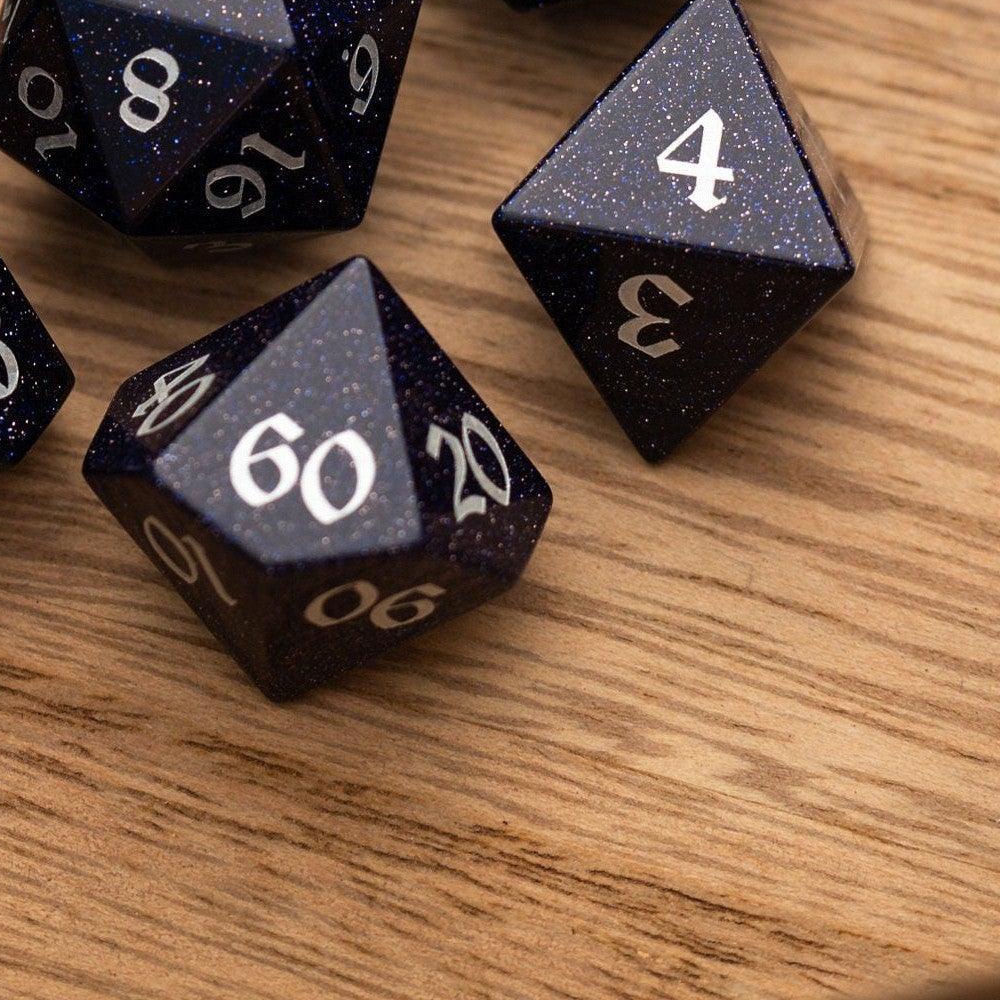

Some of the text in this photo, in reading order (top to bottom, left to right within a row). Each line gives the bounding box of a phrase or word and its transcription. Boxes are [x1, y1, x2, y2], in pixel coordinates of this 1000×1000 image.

[18, 66, 78, 161] 10
[119, 47, 180, 133] 8
[205, 132, 306, 219] 16
[656, 108, 735, 213] 4
[617, 273, 694, 359] 3
[132, 353, 216, 437] 40
[229, 412, 378, 525] 60
[425, 411, 512, 522] 20
